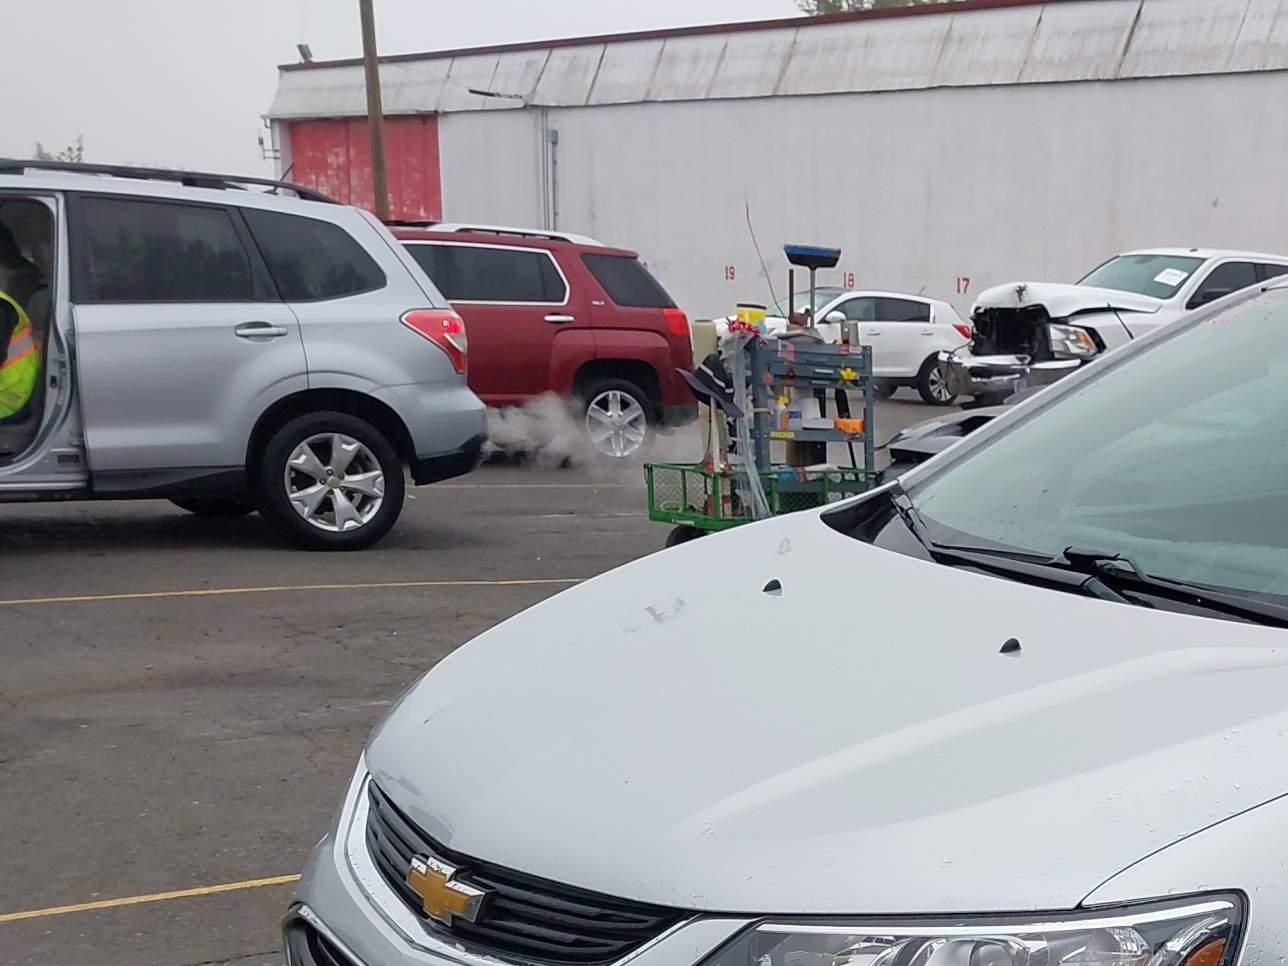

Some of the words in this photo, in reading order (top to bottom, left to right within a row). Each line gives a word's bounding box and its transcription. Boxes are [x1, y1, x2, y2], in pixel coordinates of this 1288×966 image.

[724, 265, 736, 281] 19
[843, 271, 855, 289] 18
[956, 277, 971, 294] 17
